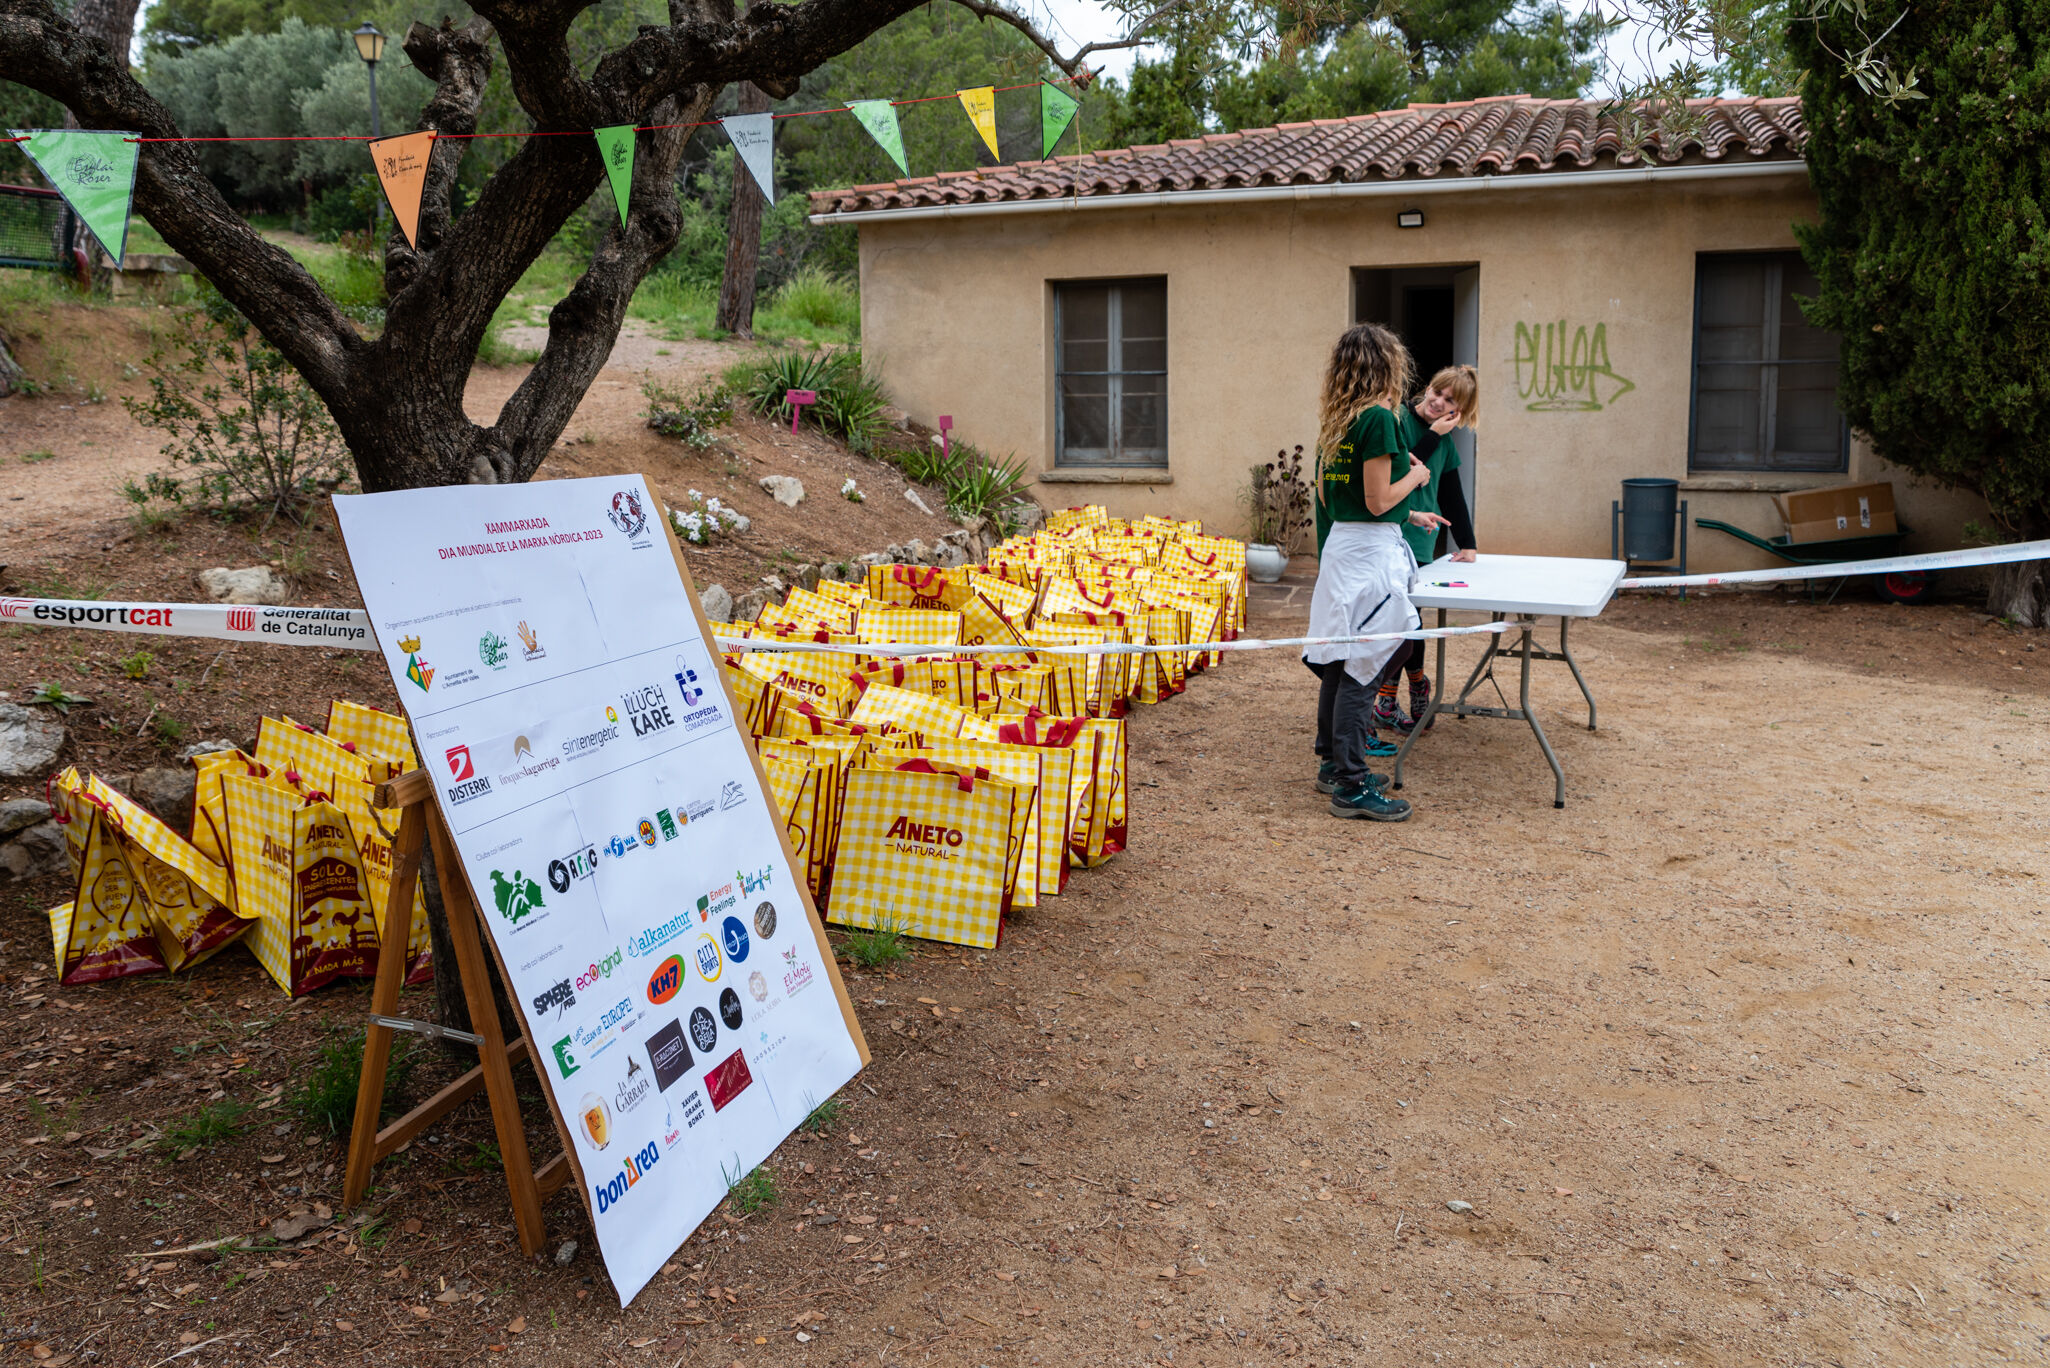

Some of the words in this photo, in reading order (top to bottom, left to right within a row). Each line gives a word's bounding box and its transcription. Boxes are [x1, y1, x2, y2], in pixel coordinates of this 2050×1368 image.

[74, 158, 114, 172] Esplai
[77, 172, 112, 186] Roser
[484, 517, 550, 535] XAMMARXADA
[438, 546, 457, 560] DIA
[457, 542, 496, 556] MUNDIAL
[497, 540, 507, 553] DE
[507, 539, 518, 551] LA
[519, 535, 549, 549] MARXA
[549, 531, 583, 546] NÒRDICA
[583, 528, 604, 542] 2023
[33, 605, 173, 627] esportcat
[263, 607, 351, 622] Generalitat
[261, 621, 282, 634] de
[286, 623, 366, 640] Catalunya
[771, 670, 826, 698] ANETO
[932, 679, 947, 690] ETO
[623, 685, 666, 716] LLUCH
[630, 706, 675, 737] KARE
[683, 705, 718, 723] ORTOPÈDIA
[690, 805, 715, 822] garriguenc
[305, 824, 345, 844] ANETO
[885, 815, 963, 847] ANETO
[262, 834, 291, 870] ANE
[312, 841, 342, 852] NATURAL
[361, 833, 392, 868] ANET
[896, 843, 949, 860] NATURAL
[311, 864, 347, 882] SOLO
[364, 864, 392, 883] NATURA
[303, 876, 356, 893] INGREDIENTES
[709, 883, 732, 902] Energy
[710, 895, 736, 916] Feelings
[638, 910, 690, 950] alkanatur
[343, 955, 364, 967] MÁS
[697, 941, 715, 964] CITY
[701, 956, 719, 975] SPORTS
[533, 978, 574, 1016] SPHERE
[563, 995, 576, 1010] PRO
[600, 996, 633, 1030] EUROPE!
[618, 1081, 627, 1097] LA
[681, 1090, 699, 1109] XAVIER
[688, 1109, 706, 1129] BONET
